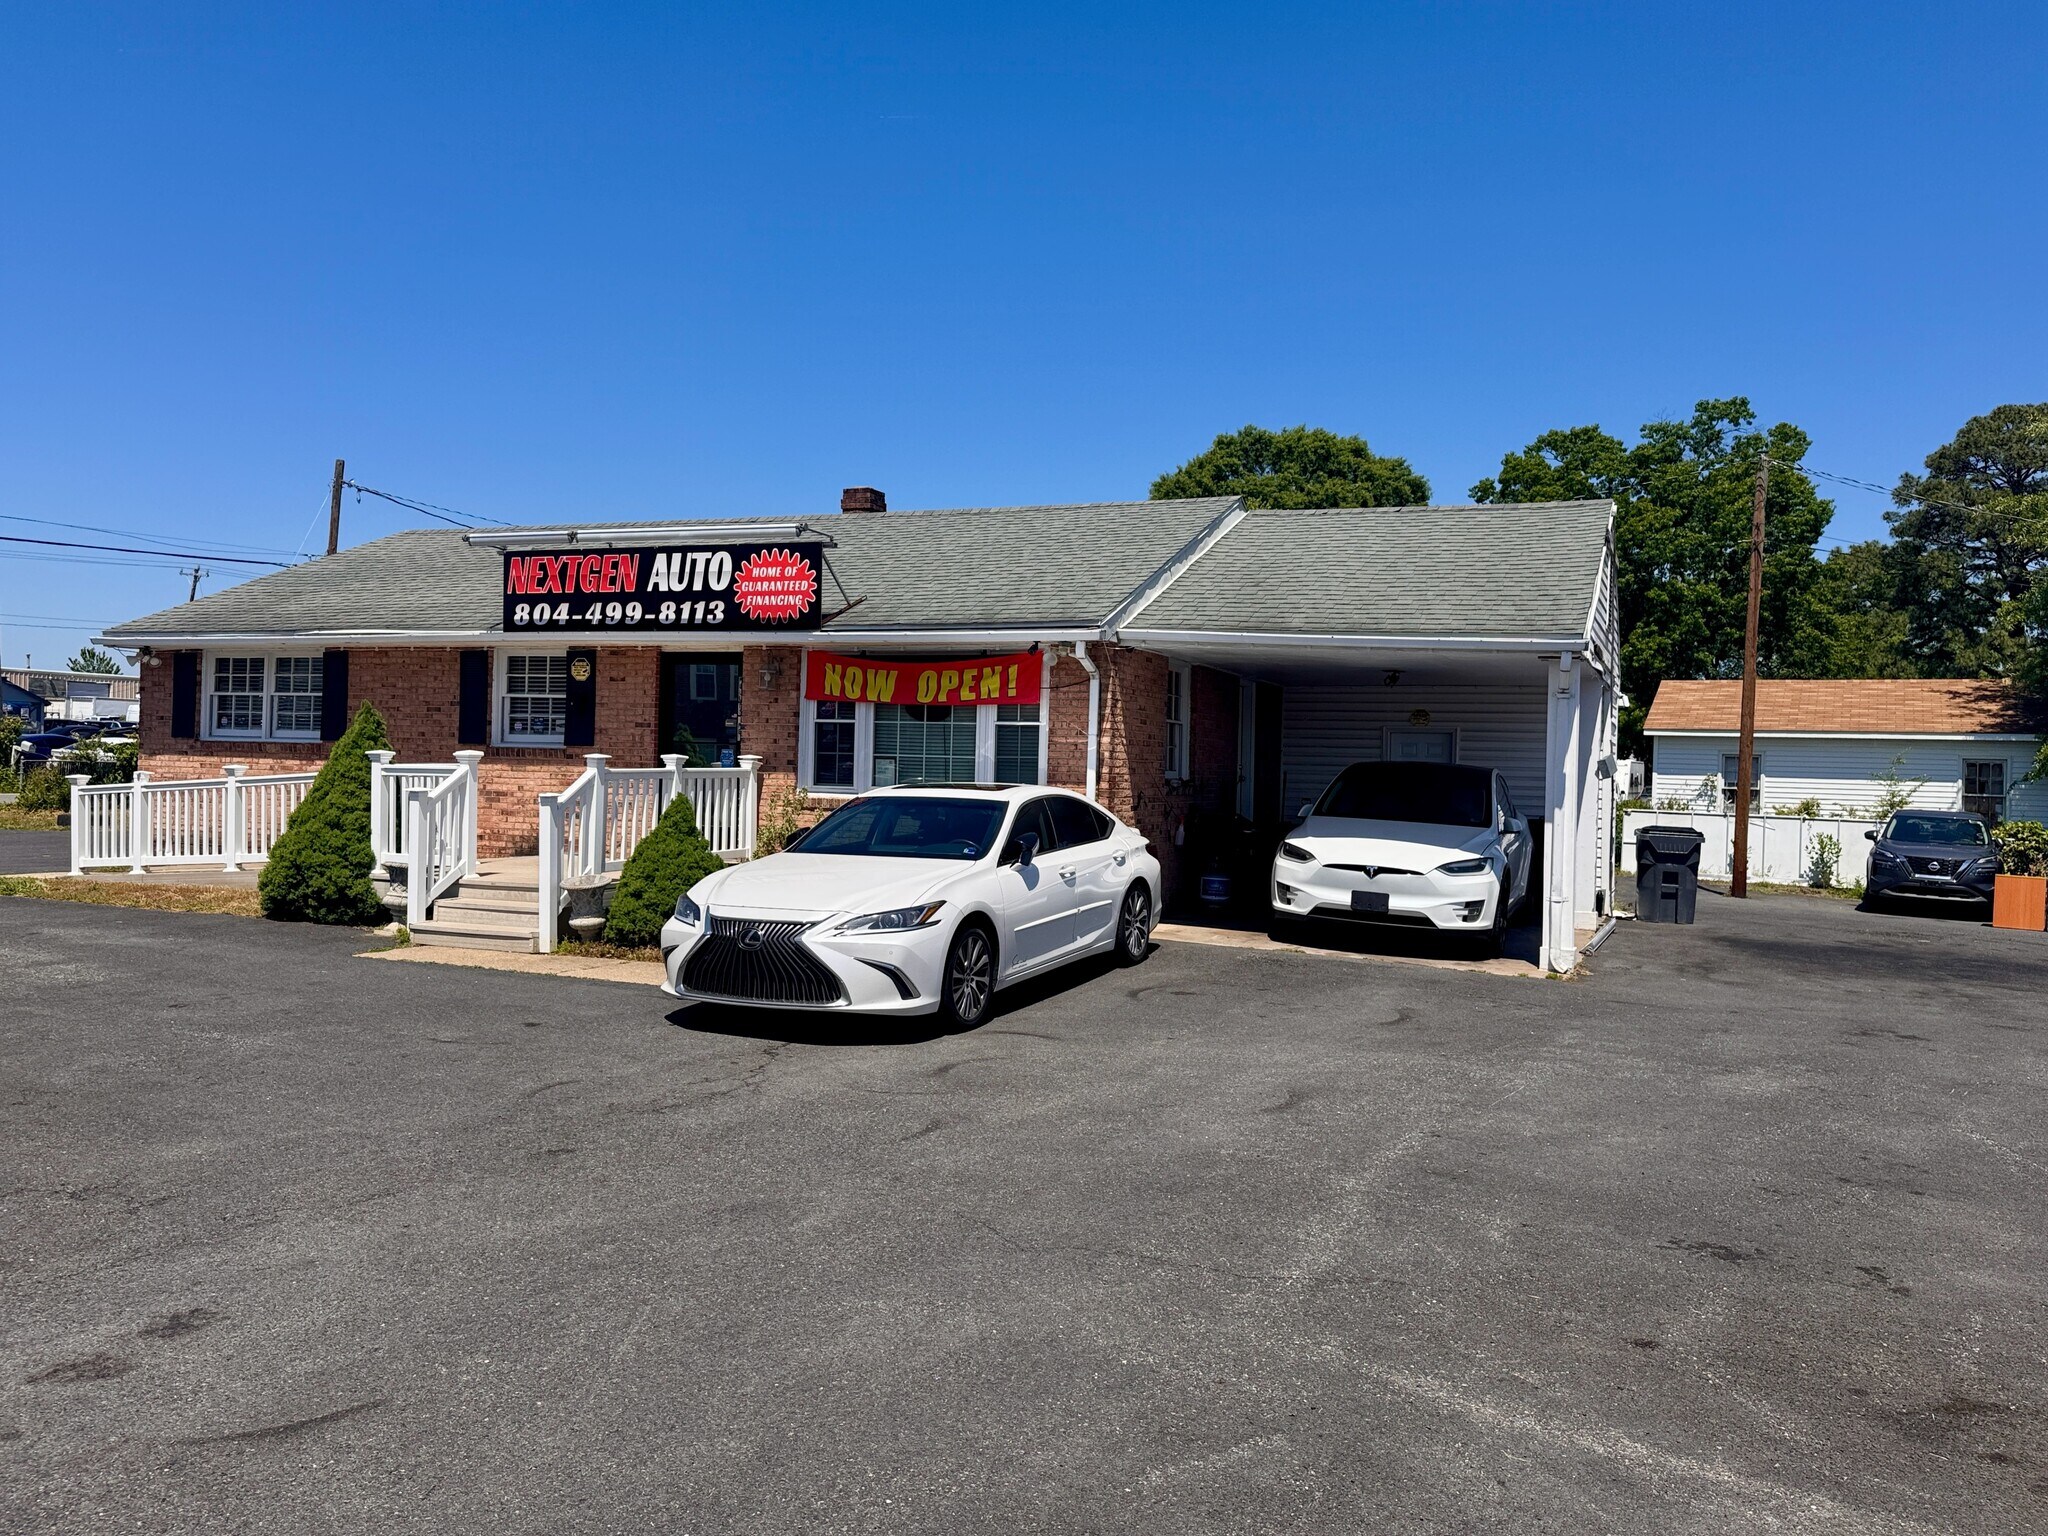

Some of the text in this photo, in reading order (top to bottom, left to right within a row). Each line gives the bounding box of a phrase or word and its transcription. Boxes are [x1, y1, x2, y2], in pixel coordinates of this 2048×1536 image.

[507, 551, 733, 595] NEXTGEN AUTO
[752, 566, 799, 578] HOME OF
[741, 580, 809, 592] GUARANTEED
[746, 594, 803, 606] FINANCING
[513, 600, 726, 626] 804-499-8113
[824, 662, 1019, 704] NOW OPEN!
